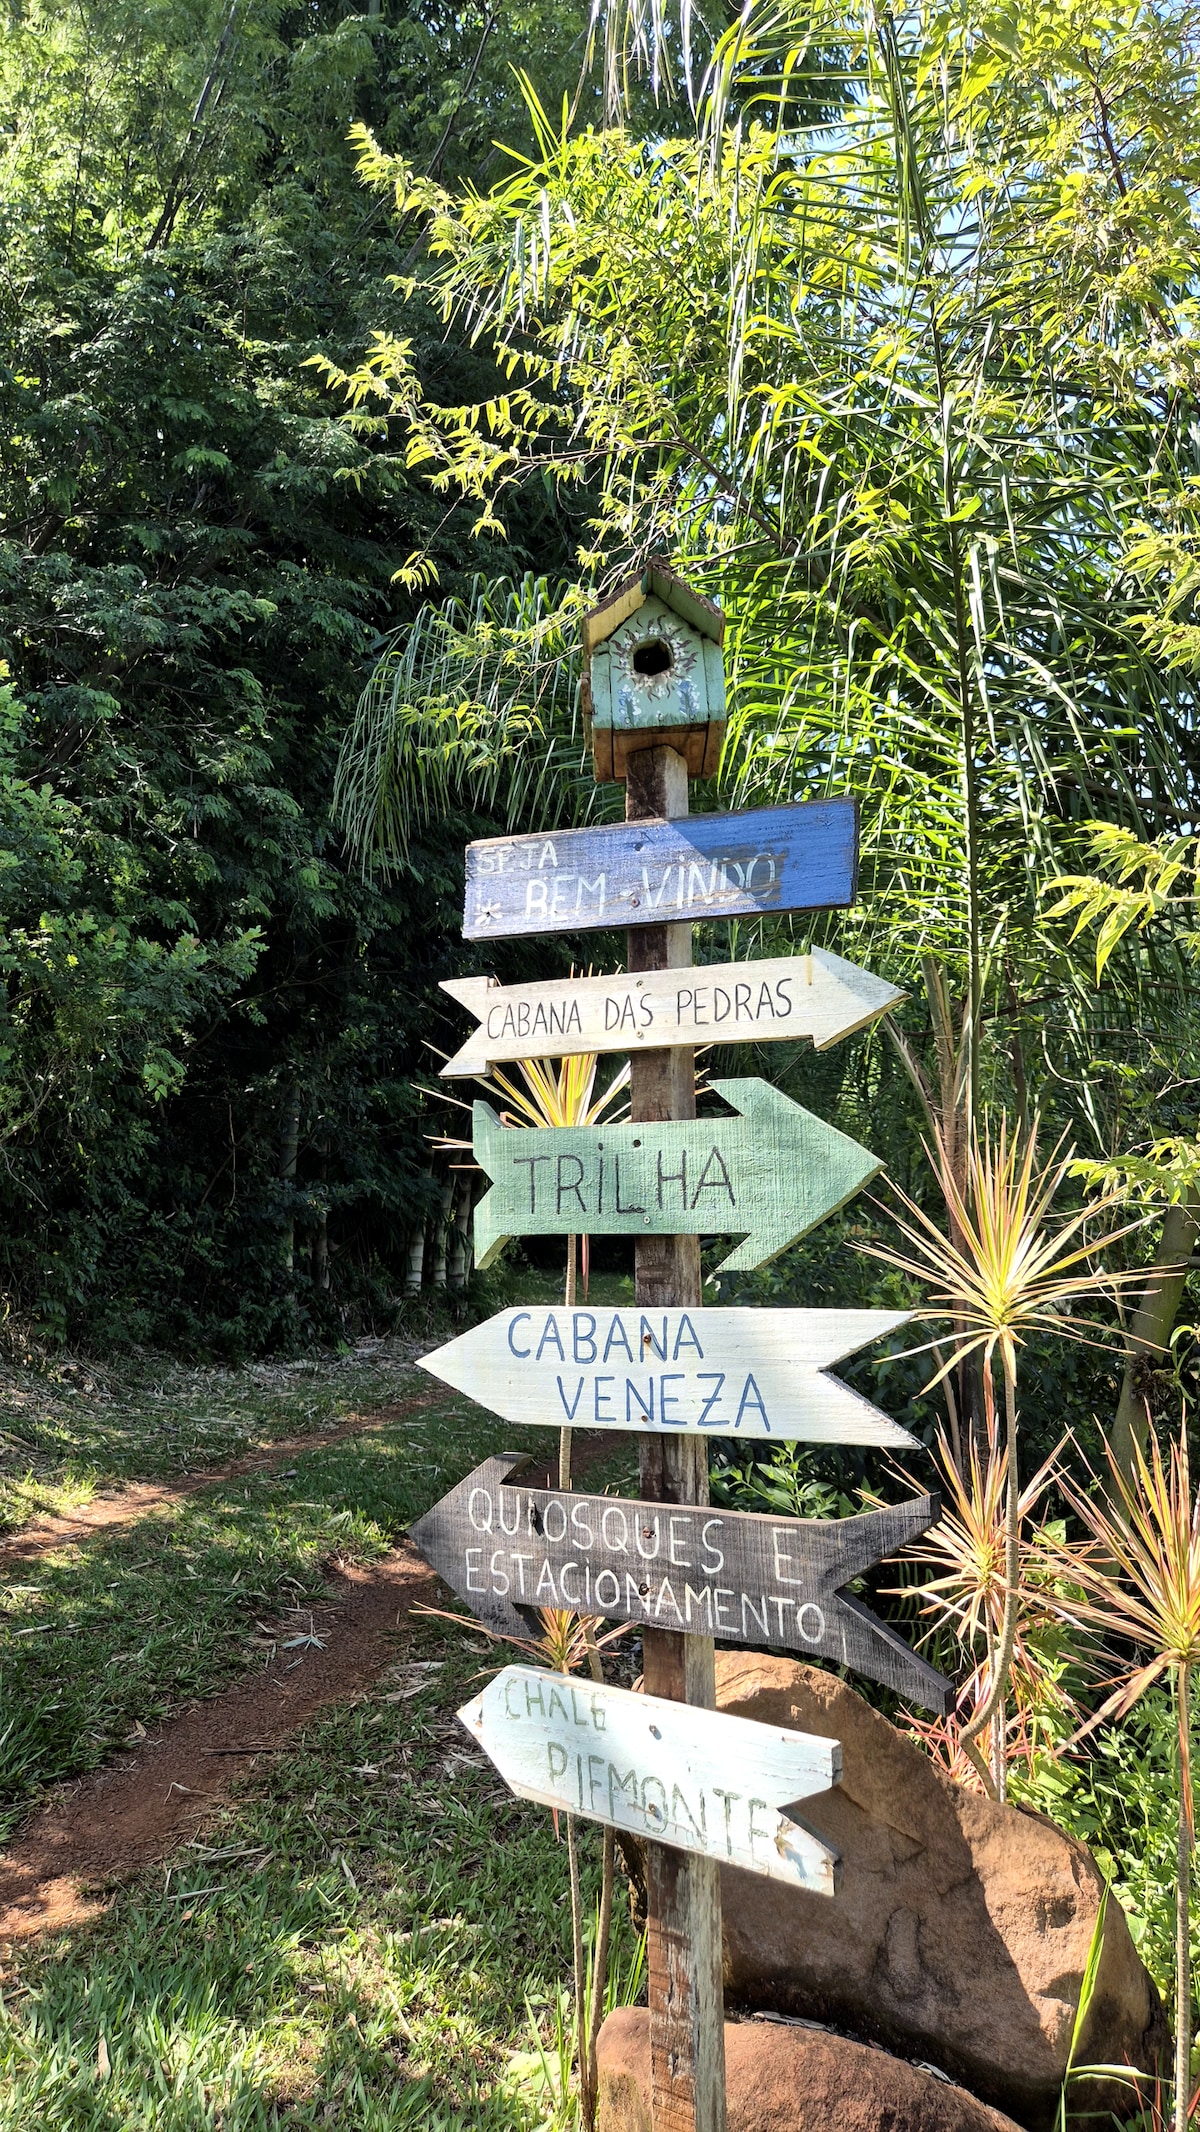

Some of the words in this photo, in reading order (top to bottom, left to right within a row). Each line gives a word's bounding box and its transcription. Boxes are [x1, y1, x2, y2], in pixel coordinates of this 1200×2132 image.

[476, 839, 559, 875] SEJA
[486, 998, 583, 1040] CABANA
[604, 992, 654, 1032] DAS
[676, 977, 793, 1027] PEDRAS
[512, 1142, 737, 1215] TRILHA
[507, 1312, 705, 1365] CABANA
[556, 1372, 772, 1433] VENEZA
[467, 1487, 726, 1575] QUIOSQUES
[773, 1526, 804, 1585] E
[464, 1547, 826, 1645] ESTACIONAMENTO
